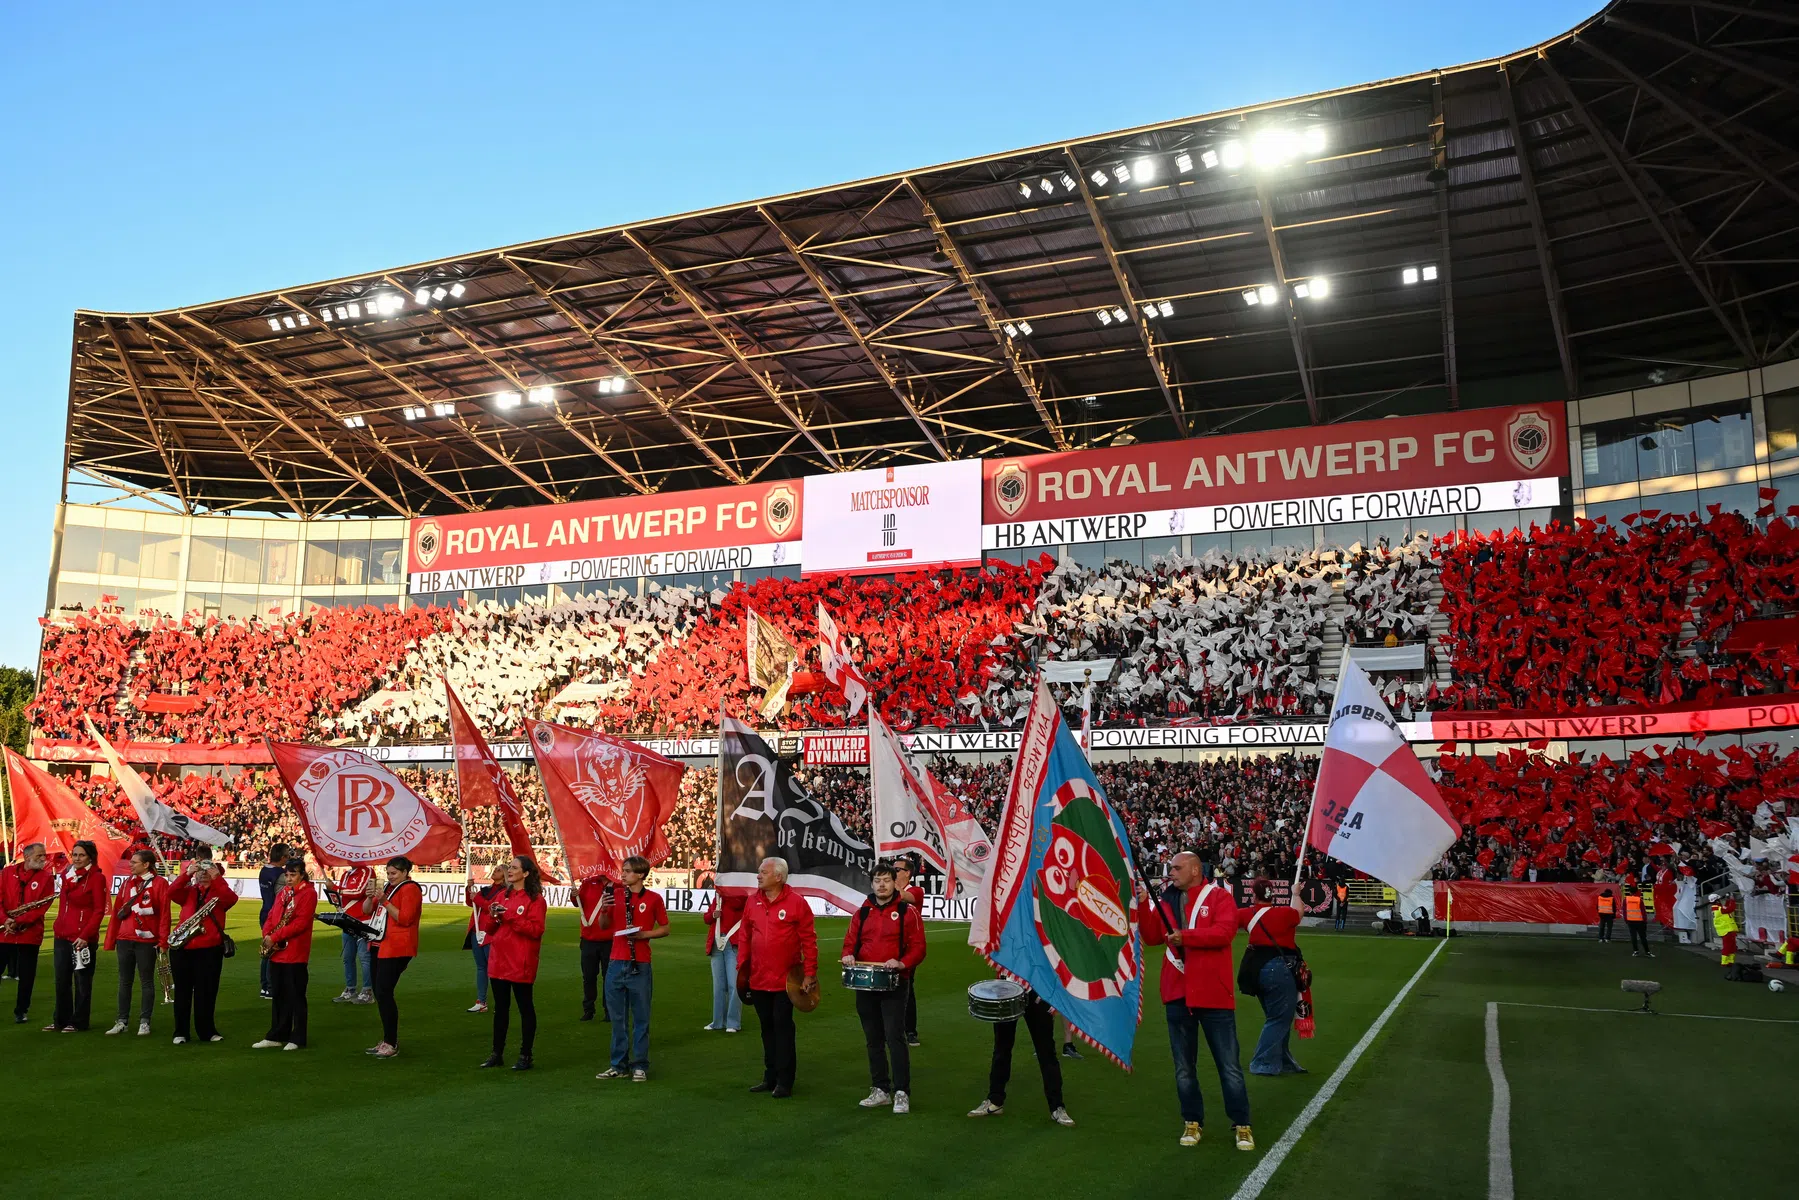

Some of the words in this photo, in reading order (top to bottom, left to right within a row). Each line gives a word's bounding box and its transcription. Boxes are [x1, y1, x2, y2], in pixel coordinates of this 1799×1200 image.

[1038, 462, 1171, 503] ROYAL
[1183, 436, 1418, 490] ANTWERP
[1434, 429, 1495, 467] FC
[851, 485, 930, 512] MATCHSPONSOR
[445, 525, 538, 556] ROYAL
[546, 505, 707, 547] ANTWERP
[716, 501, 758, 531] FC
[995, 523, 1026, 548] HB
[1032, 514, 1147, 545] ANTWERP
[1214, 497, 1343, 532] POWERING
[1352, 486, 1482, 521] FORWARD
[419, 571, 443, 593] HB
[445, 564, 526, 591] ANTWERP
[570, 554, 659, 581] POWERING
[664, 546, 753, 574] FORWARD
[911, 732, 1023, 751] ANTWERP
[1092, 725, 1220, 747] POWERING
[1229, 722, 1328, 744] FORWA
[1452, 720, 1492, 739] HB
[1502, 715, 1660, 738] ANTWERP
[807, 750, 866, 763] DYNAMITE
[809, 737, 865, 751] ANTWERP
[325, 842, 399, 860] Brasschaat
[397, 818, 425, 848] 2019
[778, 826, 796, 848] de
[890, 820, 917, 839] OLD
